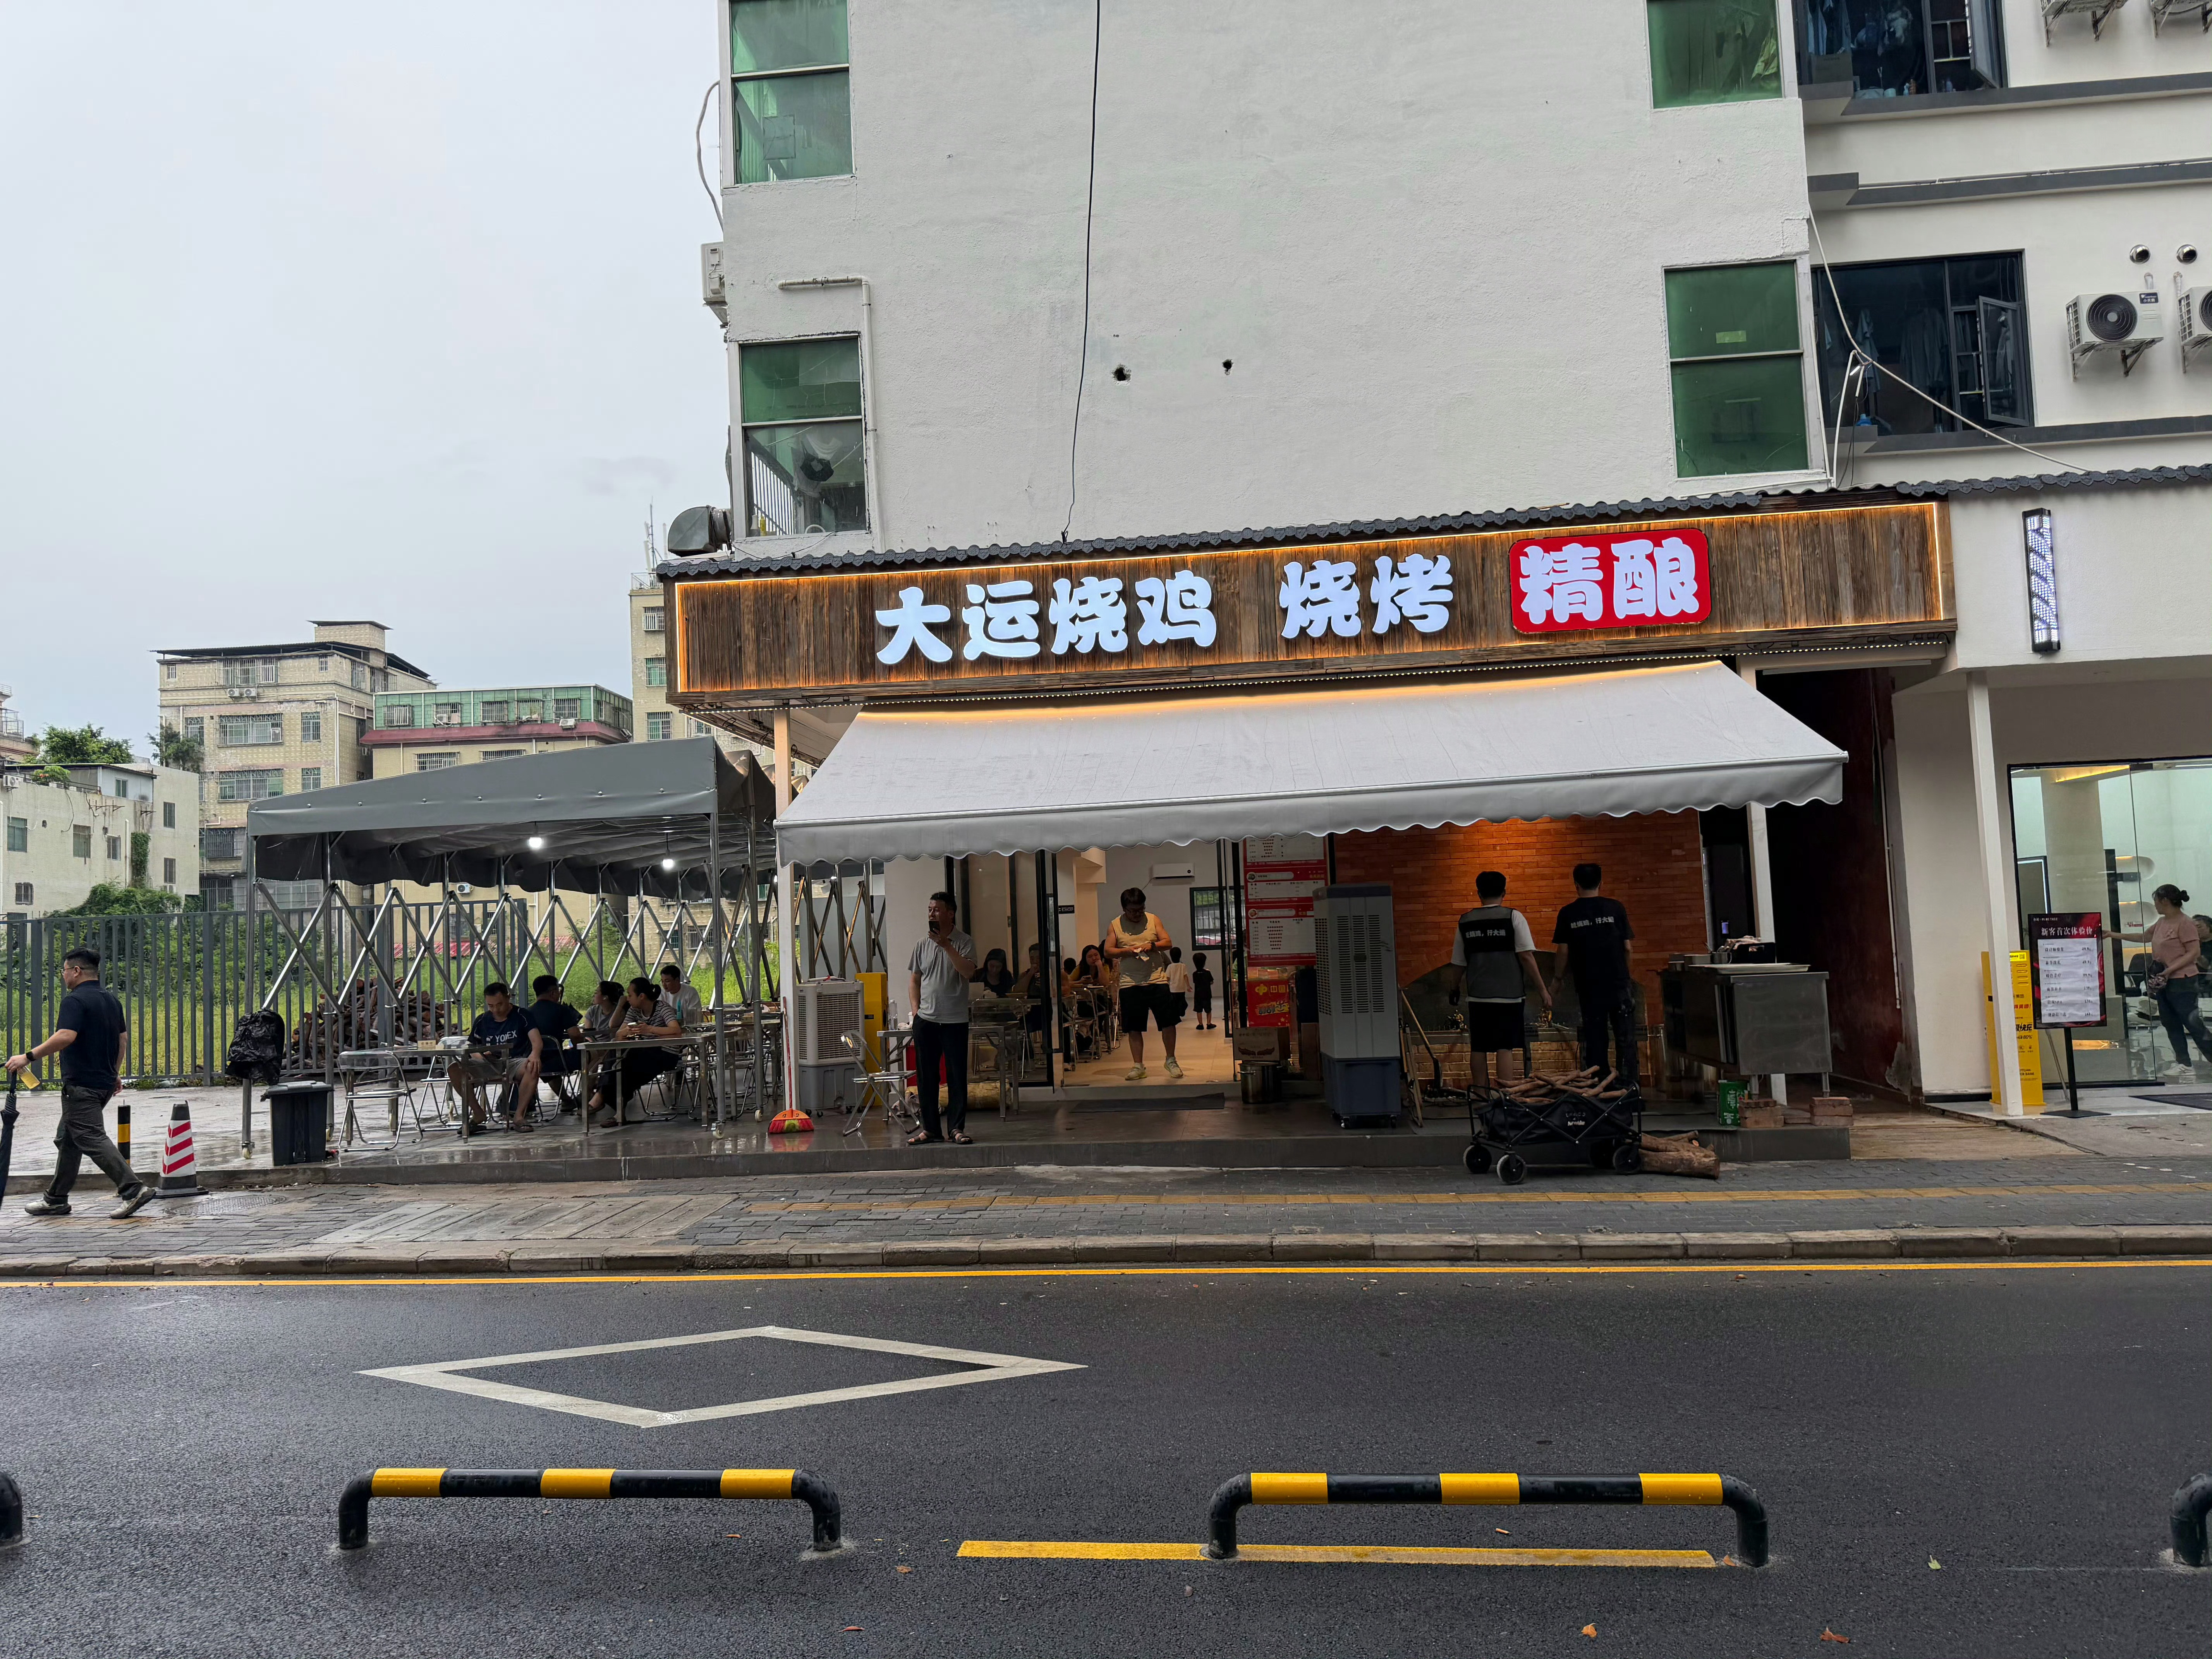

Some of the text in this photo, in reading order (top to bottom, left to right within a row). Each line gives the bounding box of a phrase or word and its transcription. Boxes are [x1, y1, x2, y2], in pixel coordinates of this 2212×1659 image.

[875, 527, 1699, 665] 大运烧鸡 烧烤 精酿
[2041, 926, 2093, 936] 新客首次体验价
[1270, 984, 1289, 993] 中国
